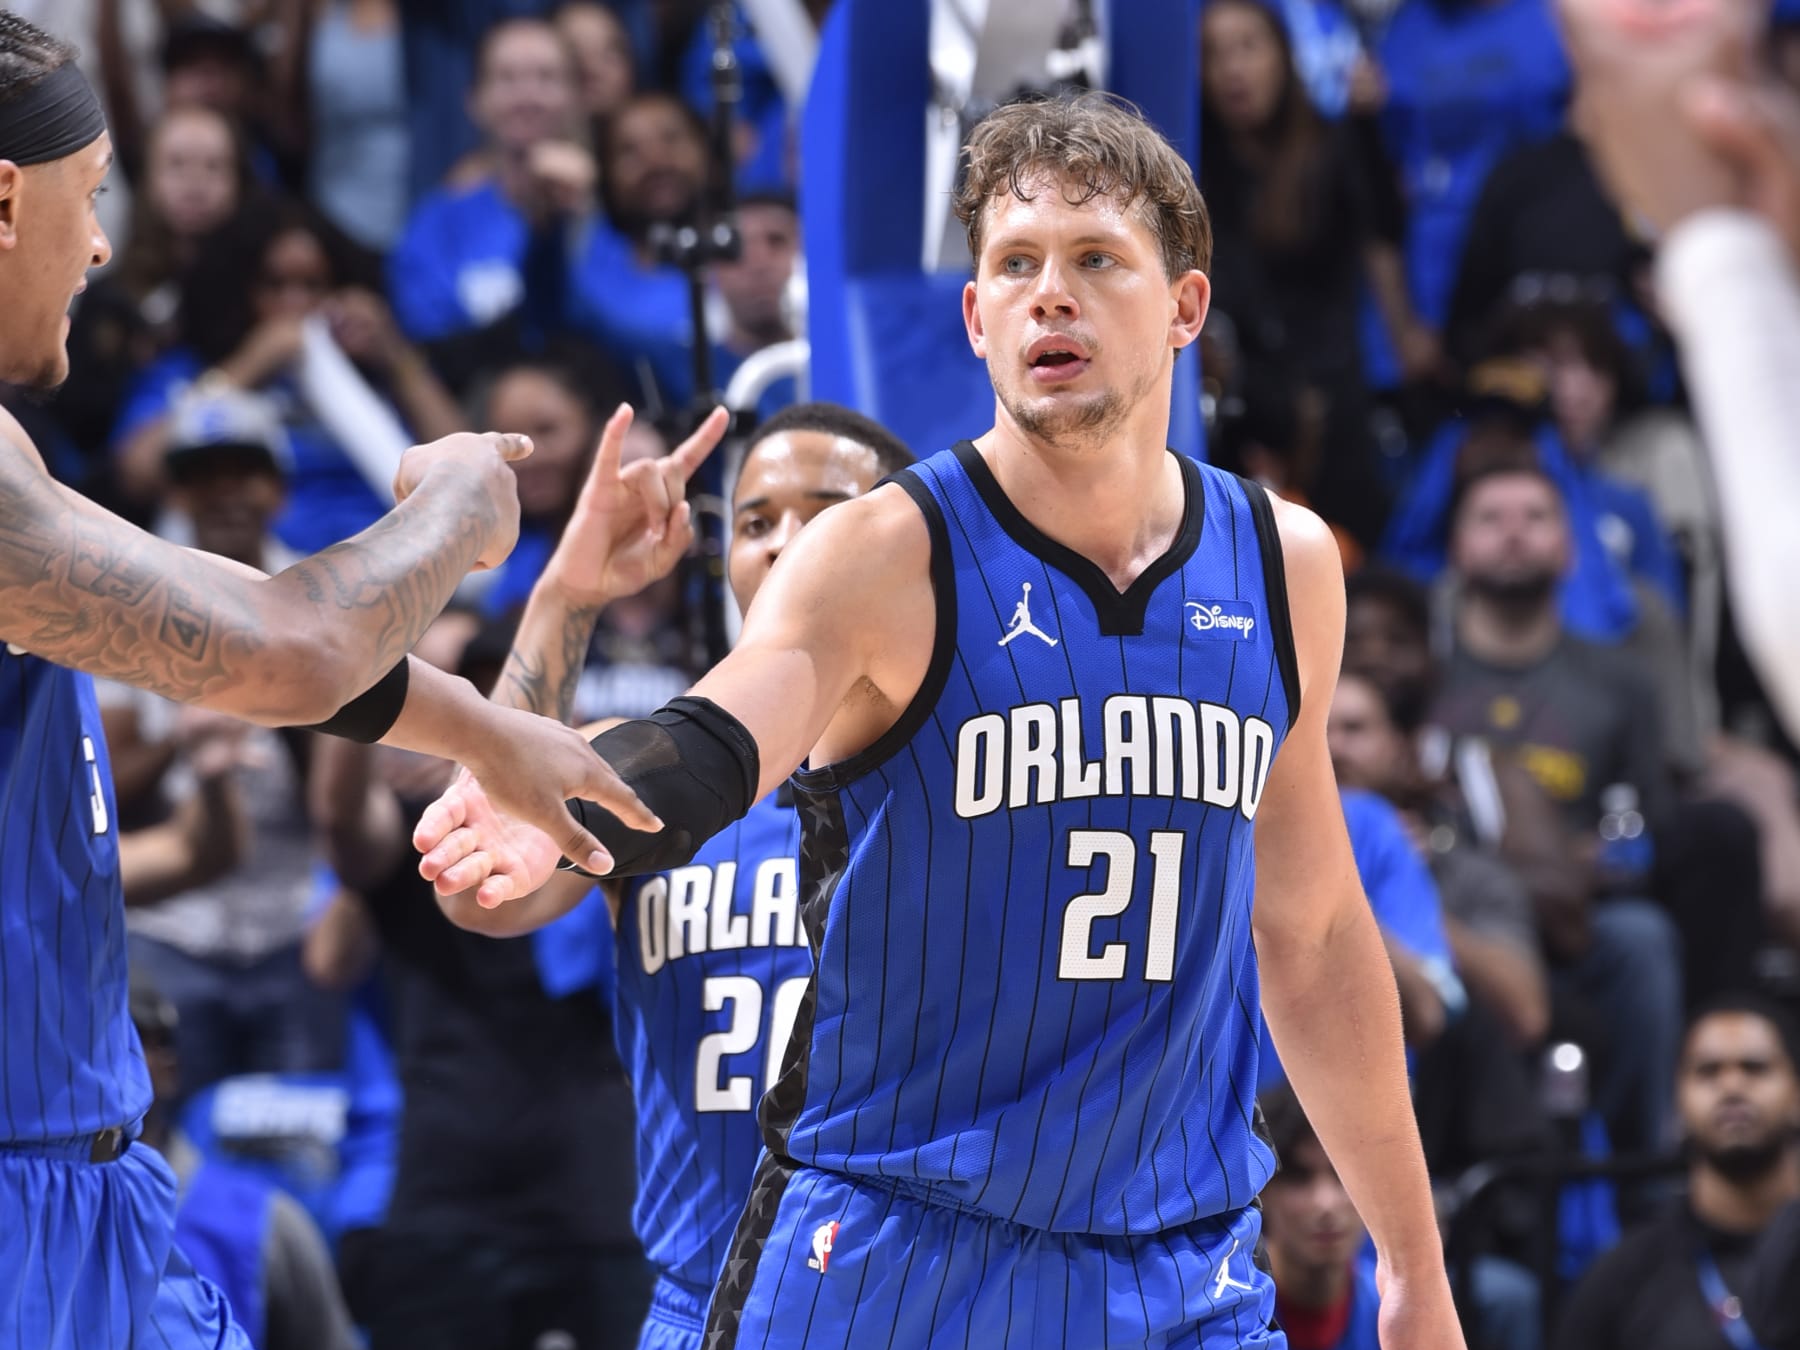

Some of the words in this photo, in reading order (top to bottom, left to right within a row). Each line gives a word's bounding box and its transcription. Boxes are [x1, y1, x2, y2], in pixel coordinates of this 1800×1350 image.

[955, 695, 1272, 820] ORLANDO
[639, 858, 808, 974] ORLA
[1057, 830, 1185, 982] 21
